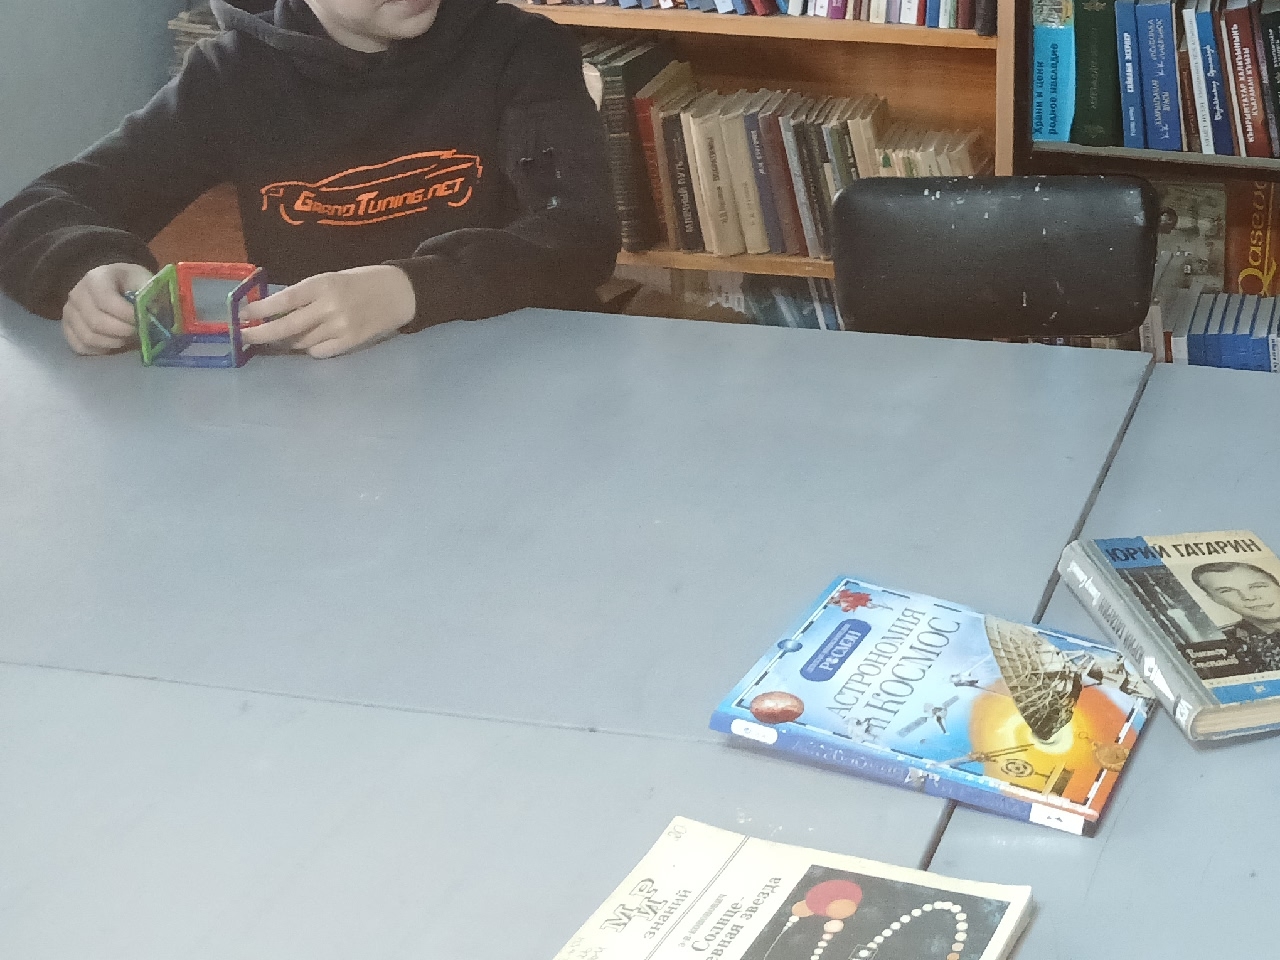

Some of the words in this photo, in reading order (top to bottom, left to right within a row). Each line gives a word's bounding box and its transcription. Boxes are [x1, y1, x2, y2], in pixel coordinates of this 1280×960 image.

[1035, 60, 1044, 88] цени
[1049, 43, 1059, 93] наследие
[1034, 101, 1044, 135] Храни
[1049, 97, 1058, 135] родное
[1105, 544, 1171, 563] ЮРИЙ
[1174, 538, 1262, 558] ГАГАРИН
[825, 607, 927, 720] АСТРОНОМИЯ
[864, 616, 961, 717] КОСМОС
[643, 889, 693, 940] знаний
[740, 876, 782, 922] звезда
